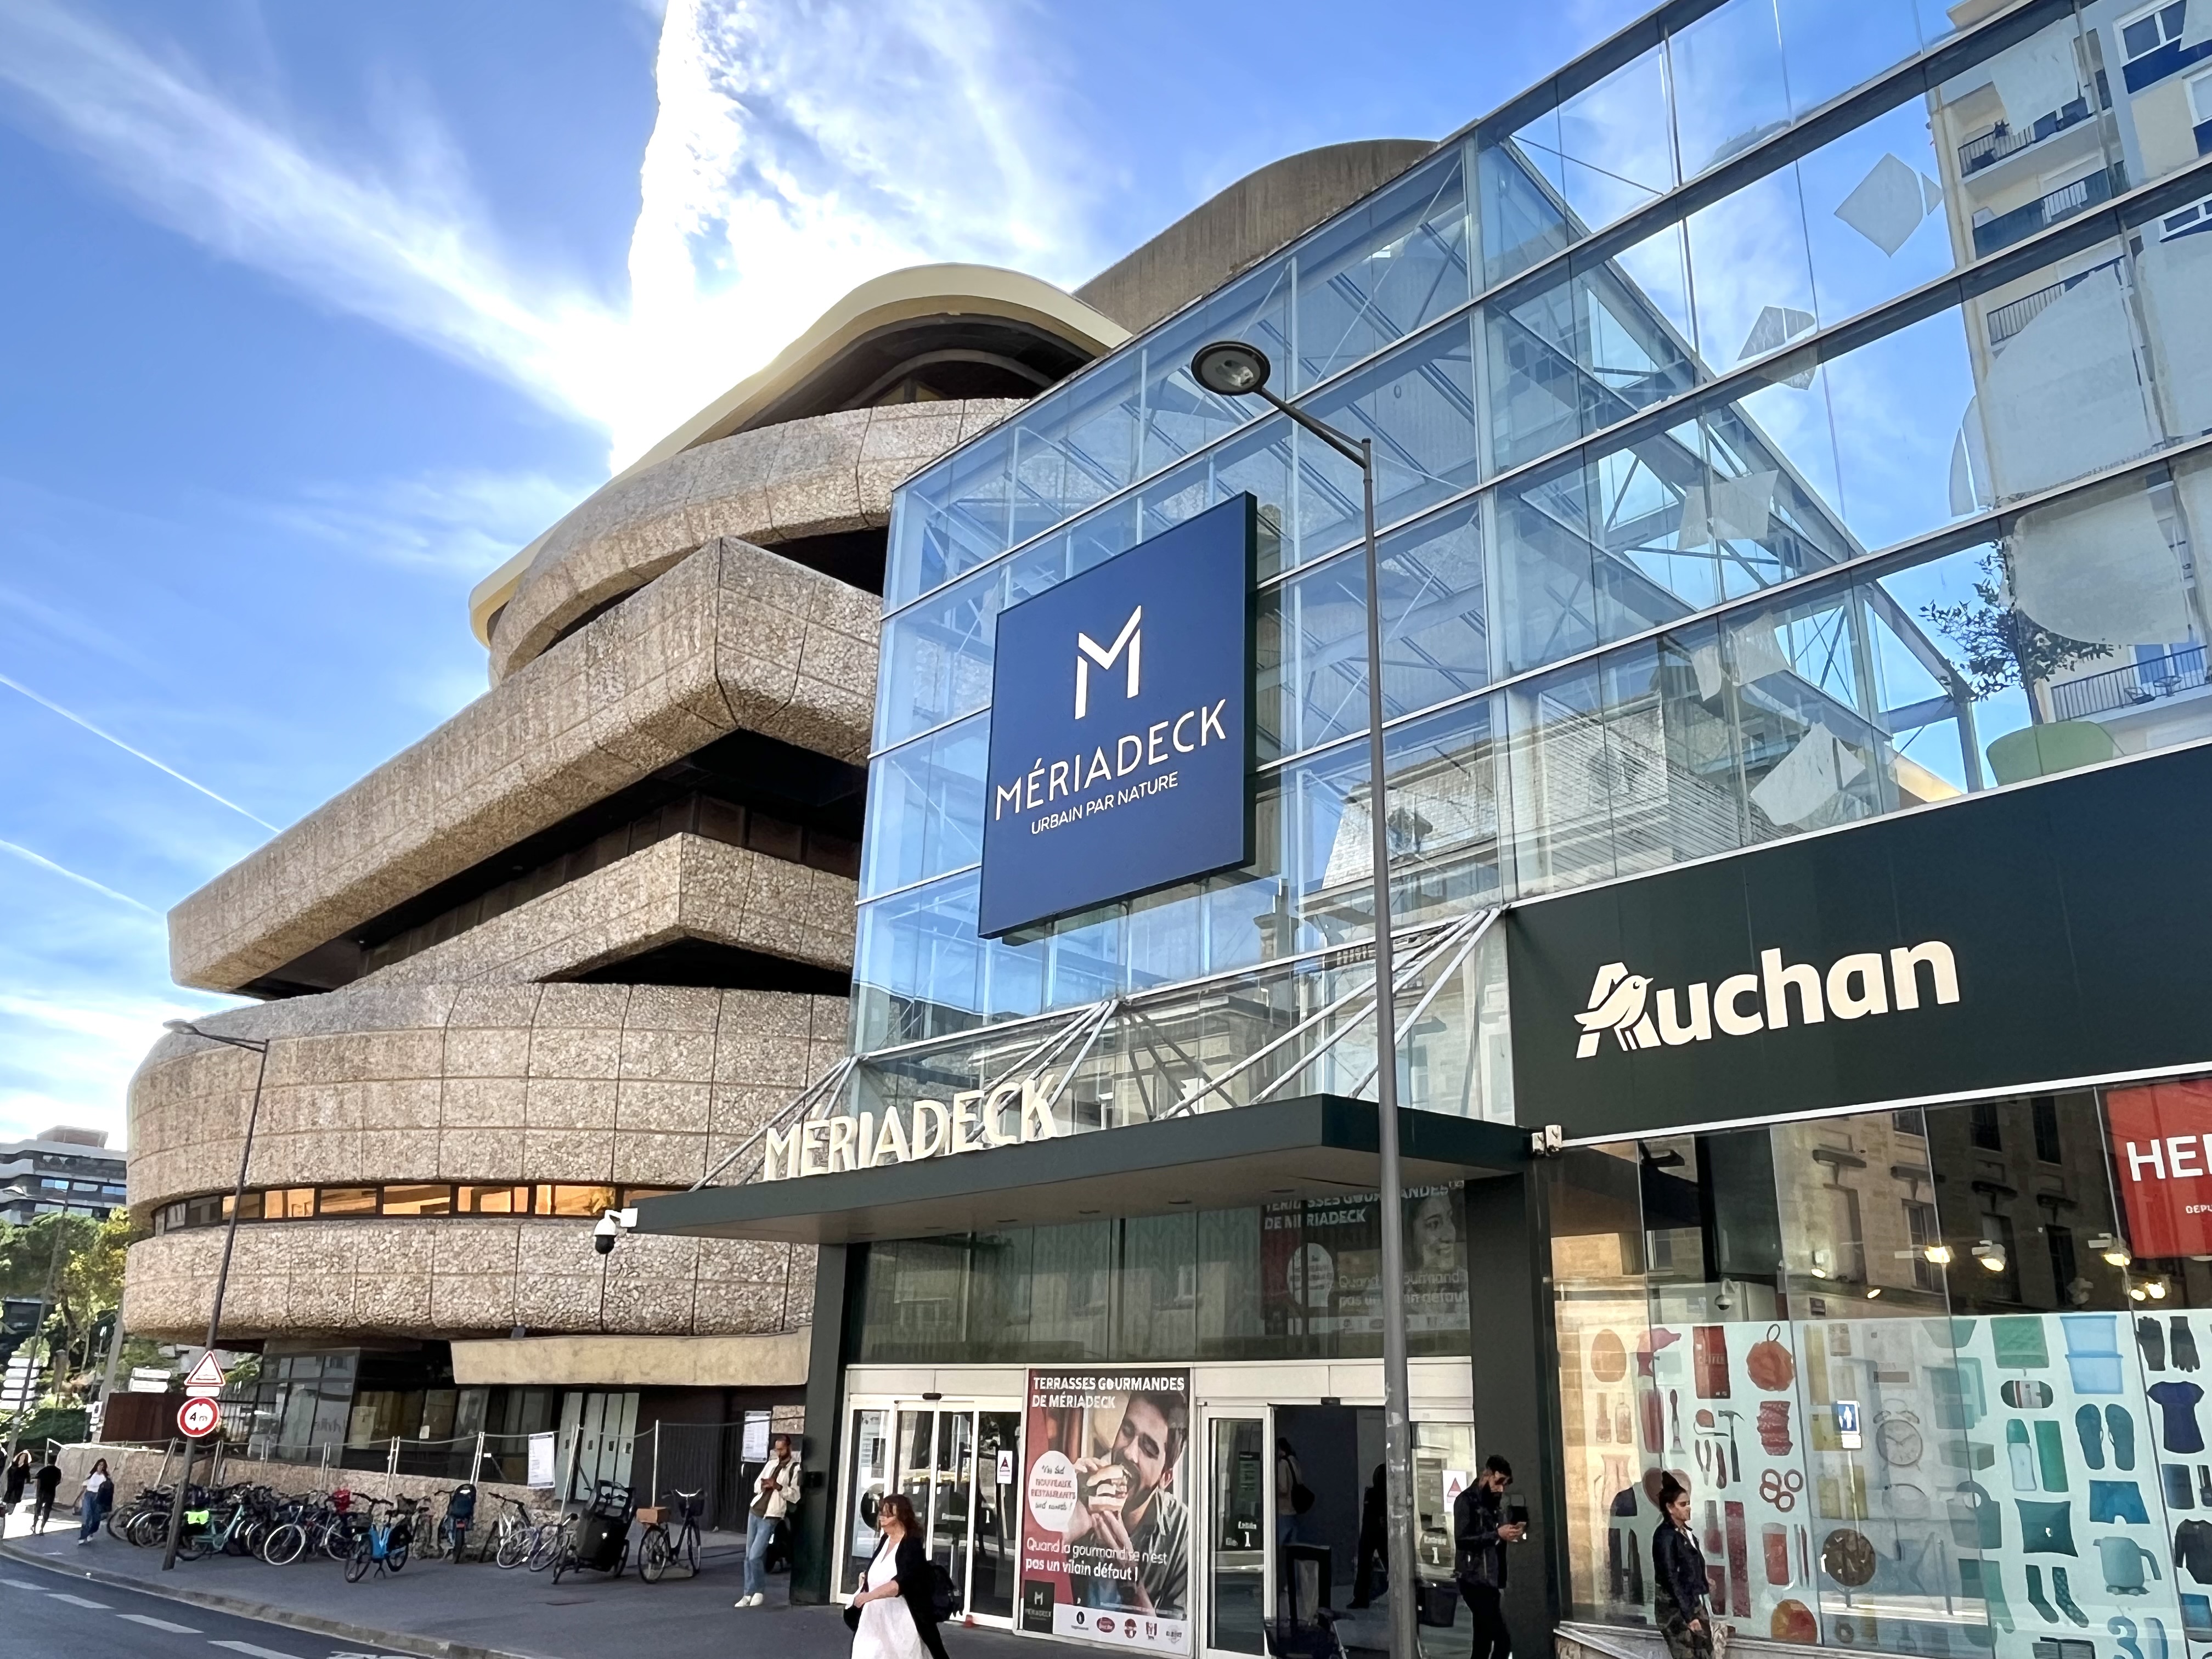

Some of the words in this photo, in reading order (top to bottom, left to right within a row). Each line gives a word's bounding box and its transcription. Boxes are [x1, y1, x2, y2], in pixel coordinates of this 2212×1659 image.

[995, 698, 1226, 821] MÉRIADECK
[1031, 805, 1083, 835] URBAIN
[1086, 794, 1114, 816] PAR
[1118, 771, 1178, 806] NATURE
[1574, 940, 1960, 1059] Auchan
[763, 1074, 1058, 1181] MÉRIADECK
[1265, 1216, 1282, 1230] DE
[1284, 1207, 1366, 1229] MRIADECK
[1034, 1377, 1096, 1390] TERRASSES
[1098, 1376, 1184, 1391] GOURMANDES
[1032, 1395, 1047, 1408] DE
[1049, 1391, 1115, 1408] MÉRIADECK
[1026, 1537, 1059, 1551] Quand
[1025, 1558, 1045, 1572] pas
[1047, 1560, 1059, 1572] un
[1063, 1560, 1091, 1576] vilain
[1093, 1562, 1132, 1581] défaut
